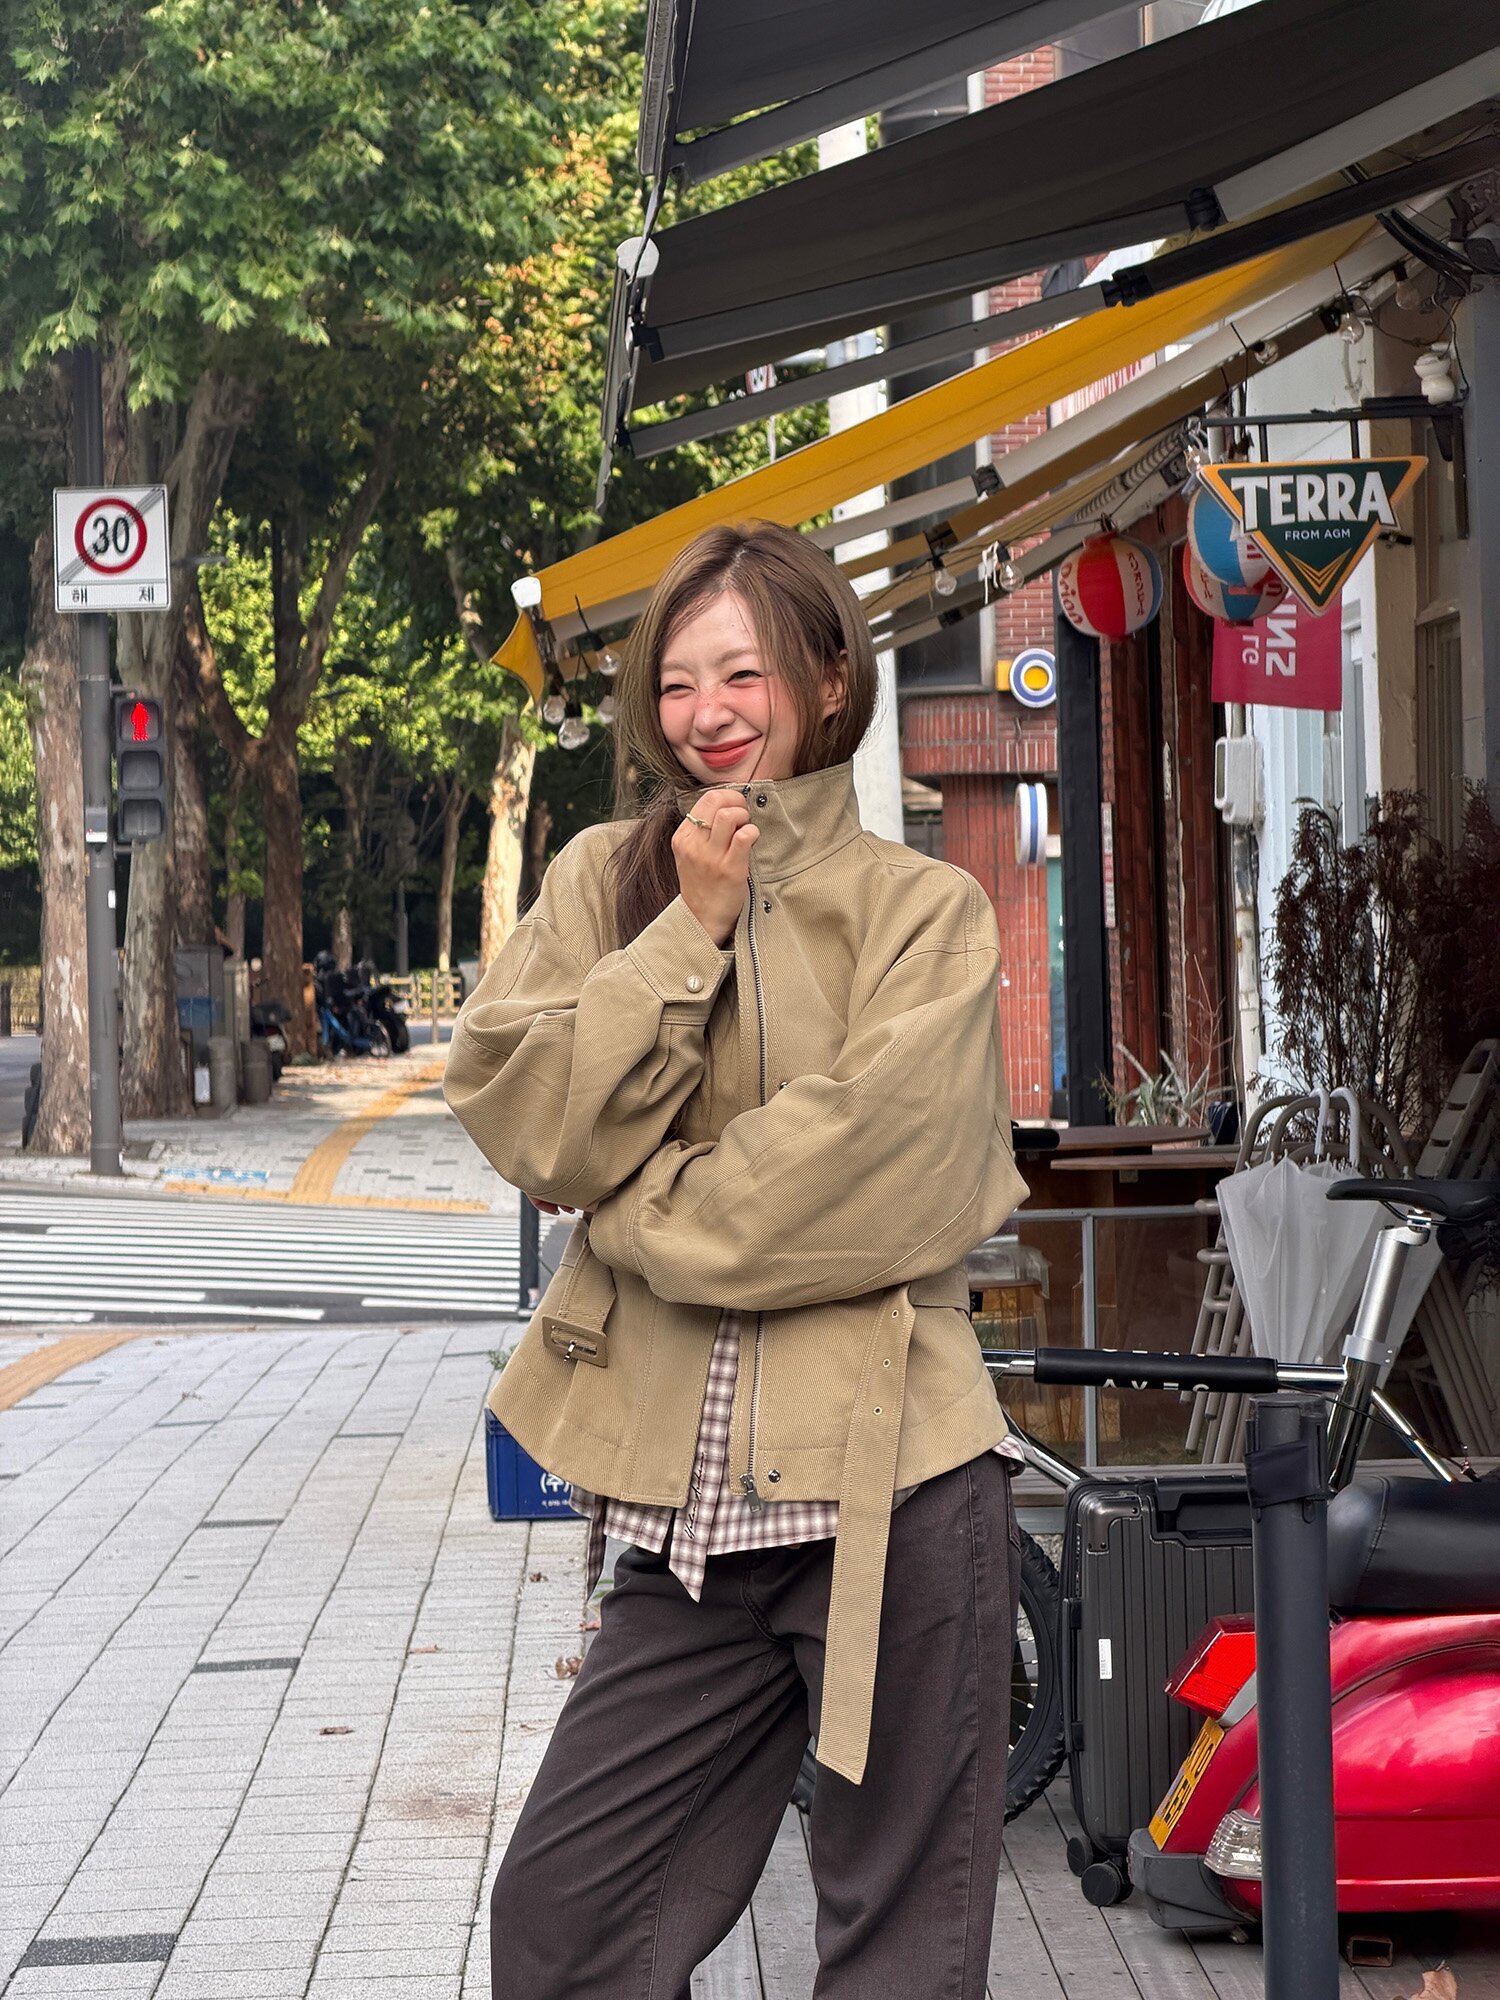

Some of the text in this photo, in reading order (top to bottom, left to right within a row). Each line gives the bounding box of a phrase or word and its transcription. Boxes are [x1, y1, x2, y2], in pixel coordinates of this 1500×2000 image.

[1231, 471, 1397, 532] TERRA
[92, 516, 130, 554] 30
[1284, 529, 1351, 541] FROM AGM
[1060, 561, 1083, 624] Orion
